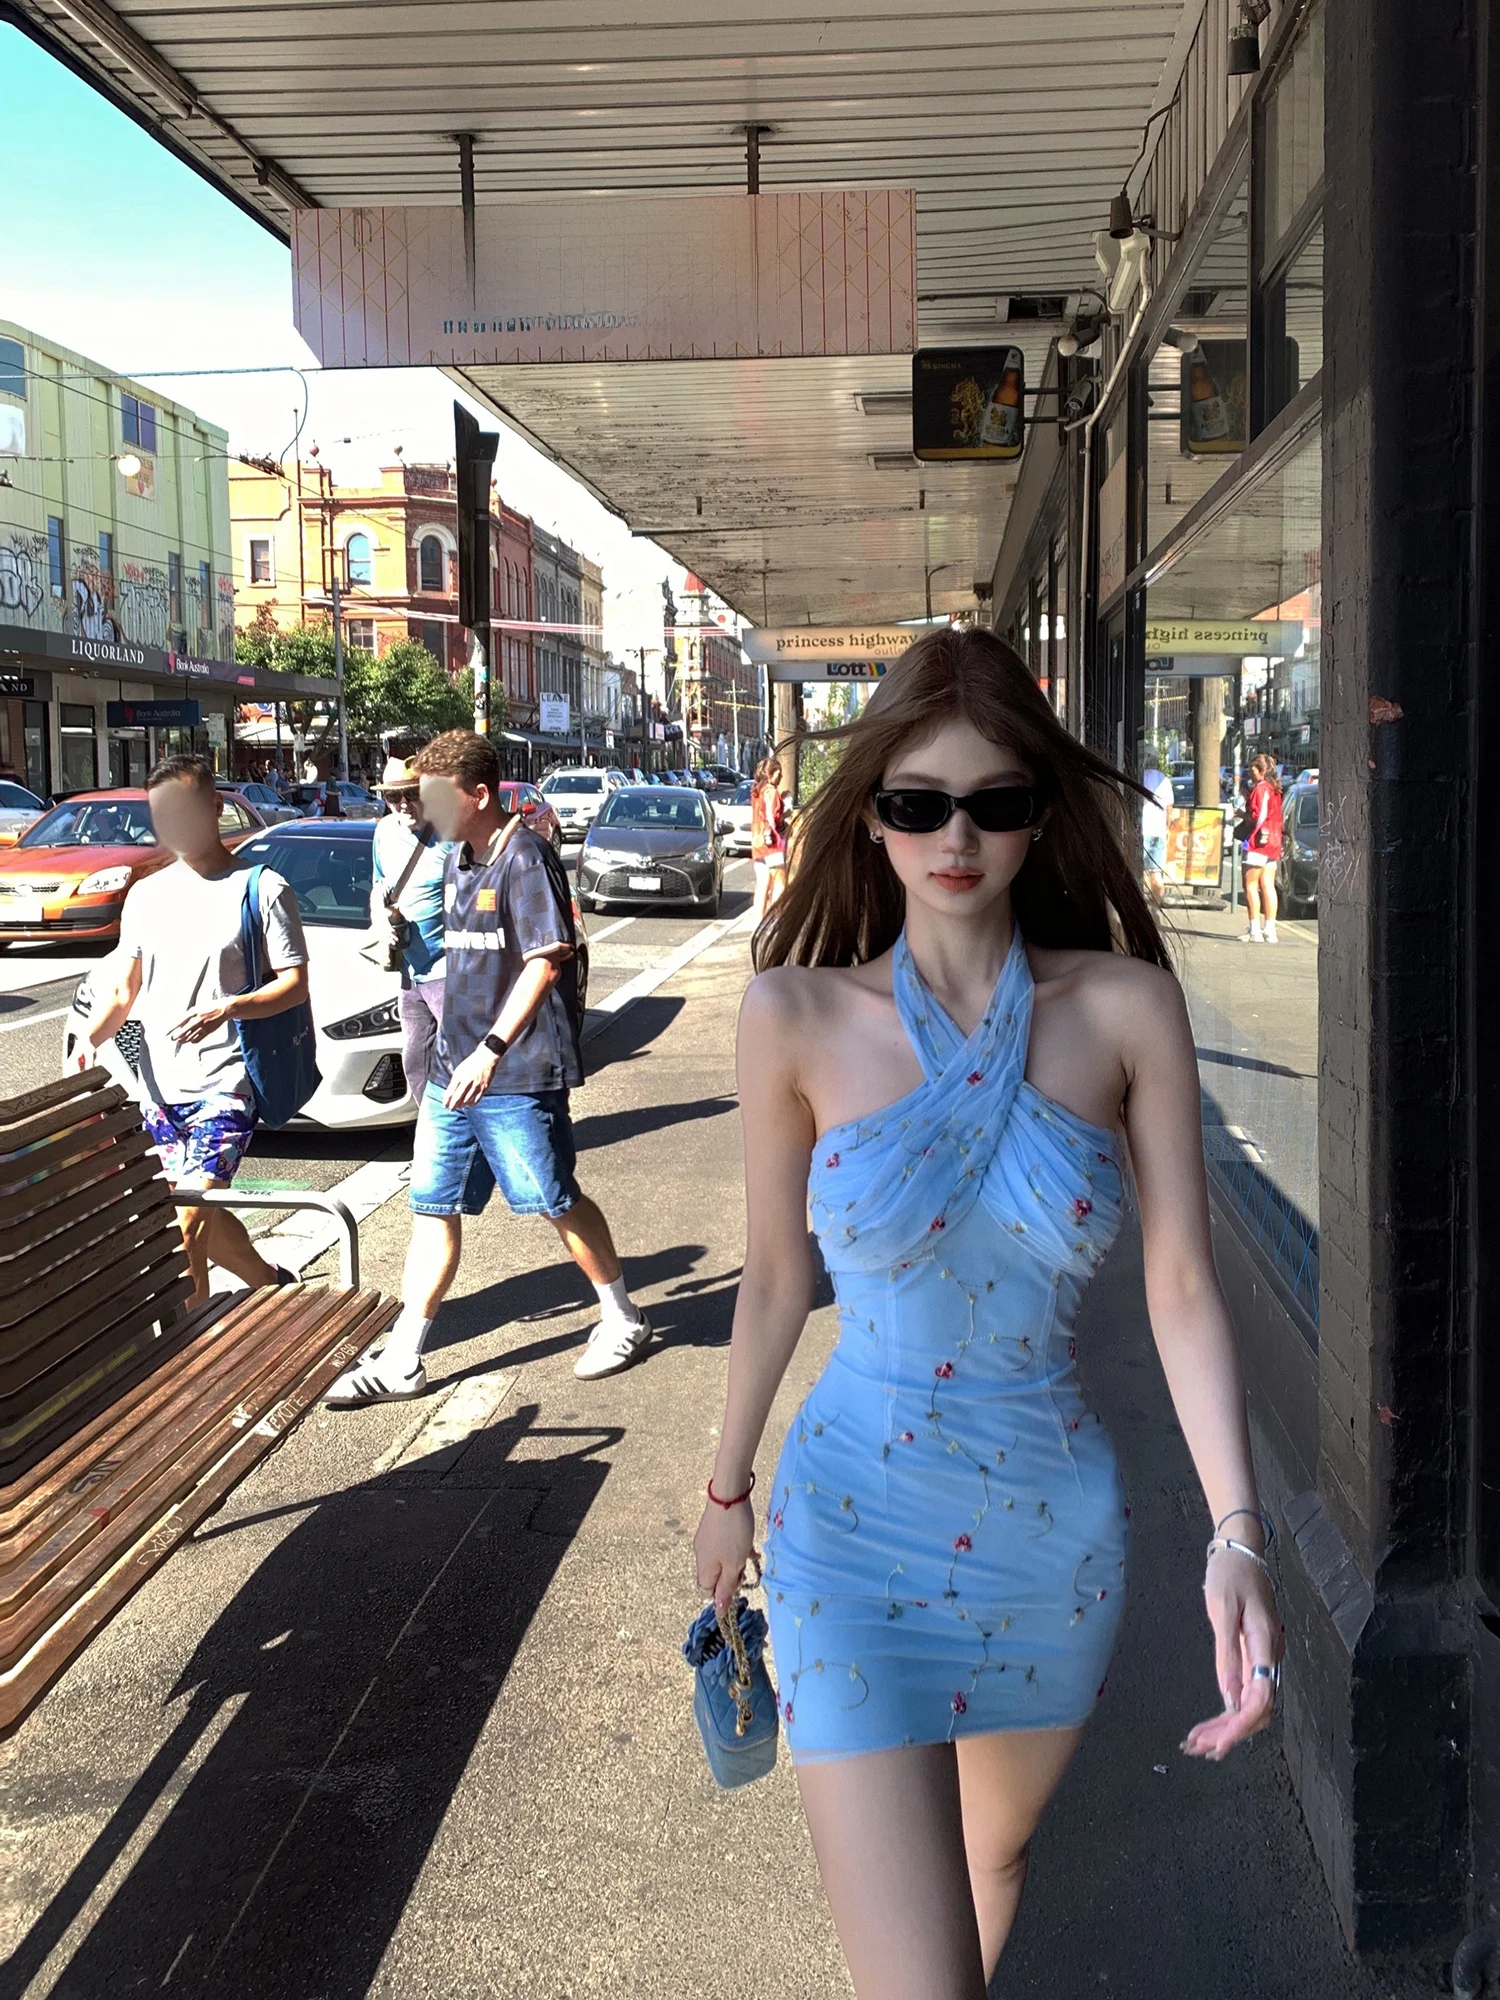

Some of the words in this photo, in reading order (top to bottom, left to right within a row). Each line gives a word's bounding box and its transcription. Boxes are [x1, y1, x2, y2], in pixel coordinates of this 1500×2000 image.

[776, 635, 844, 651] princess
[848, 633, 918, 649] highway
[71, 639, 145, 664] LIQUORLAND
[176, 658, 189, 671] Bank
[188, 661, 210, 675] Australia
[827, 663, 867, 677] Lott
[136, 709, 152, 718] Bank
[153, 708, 181, 718] Australia
